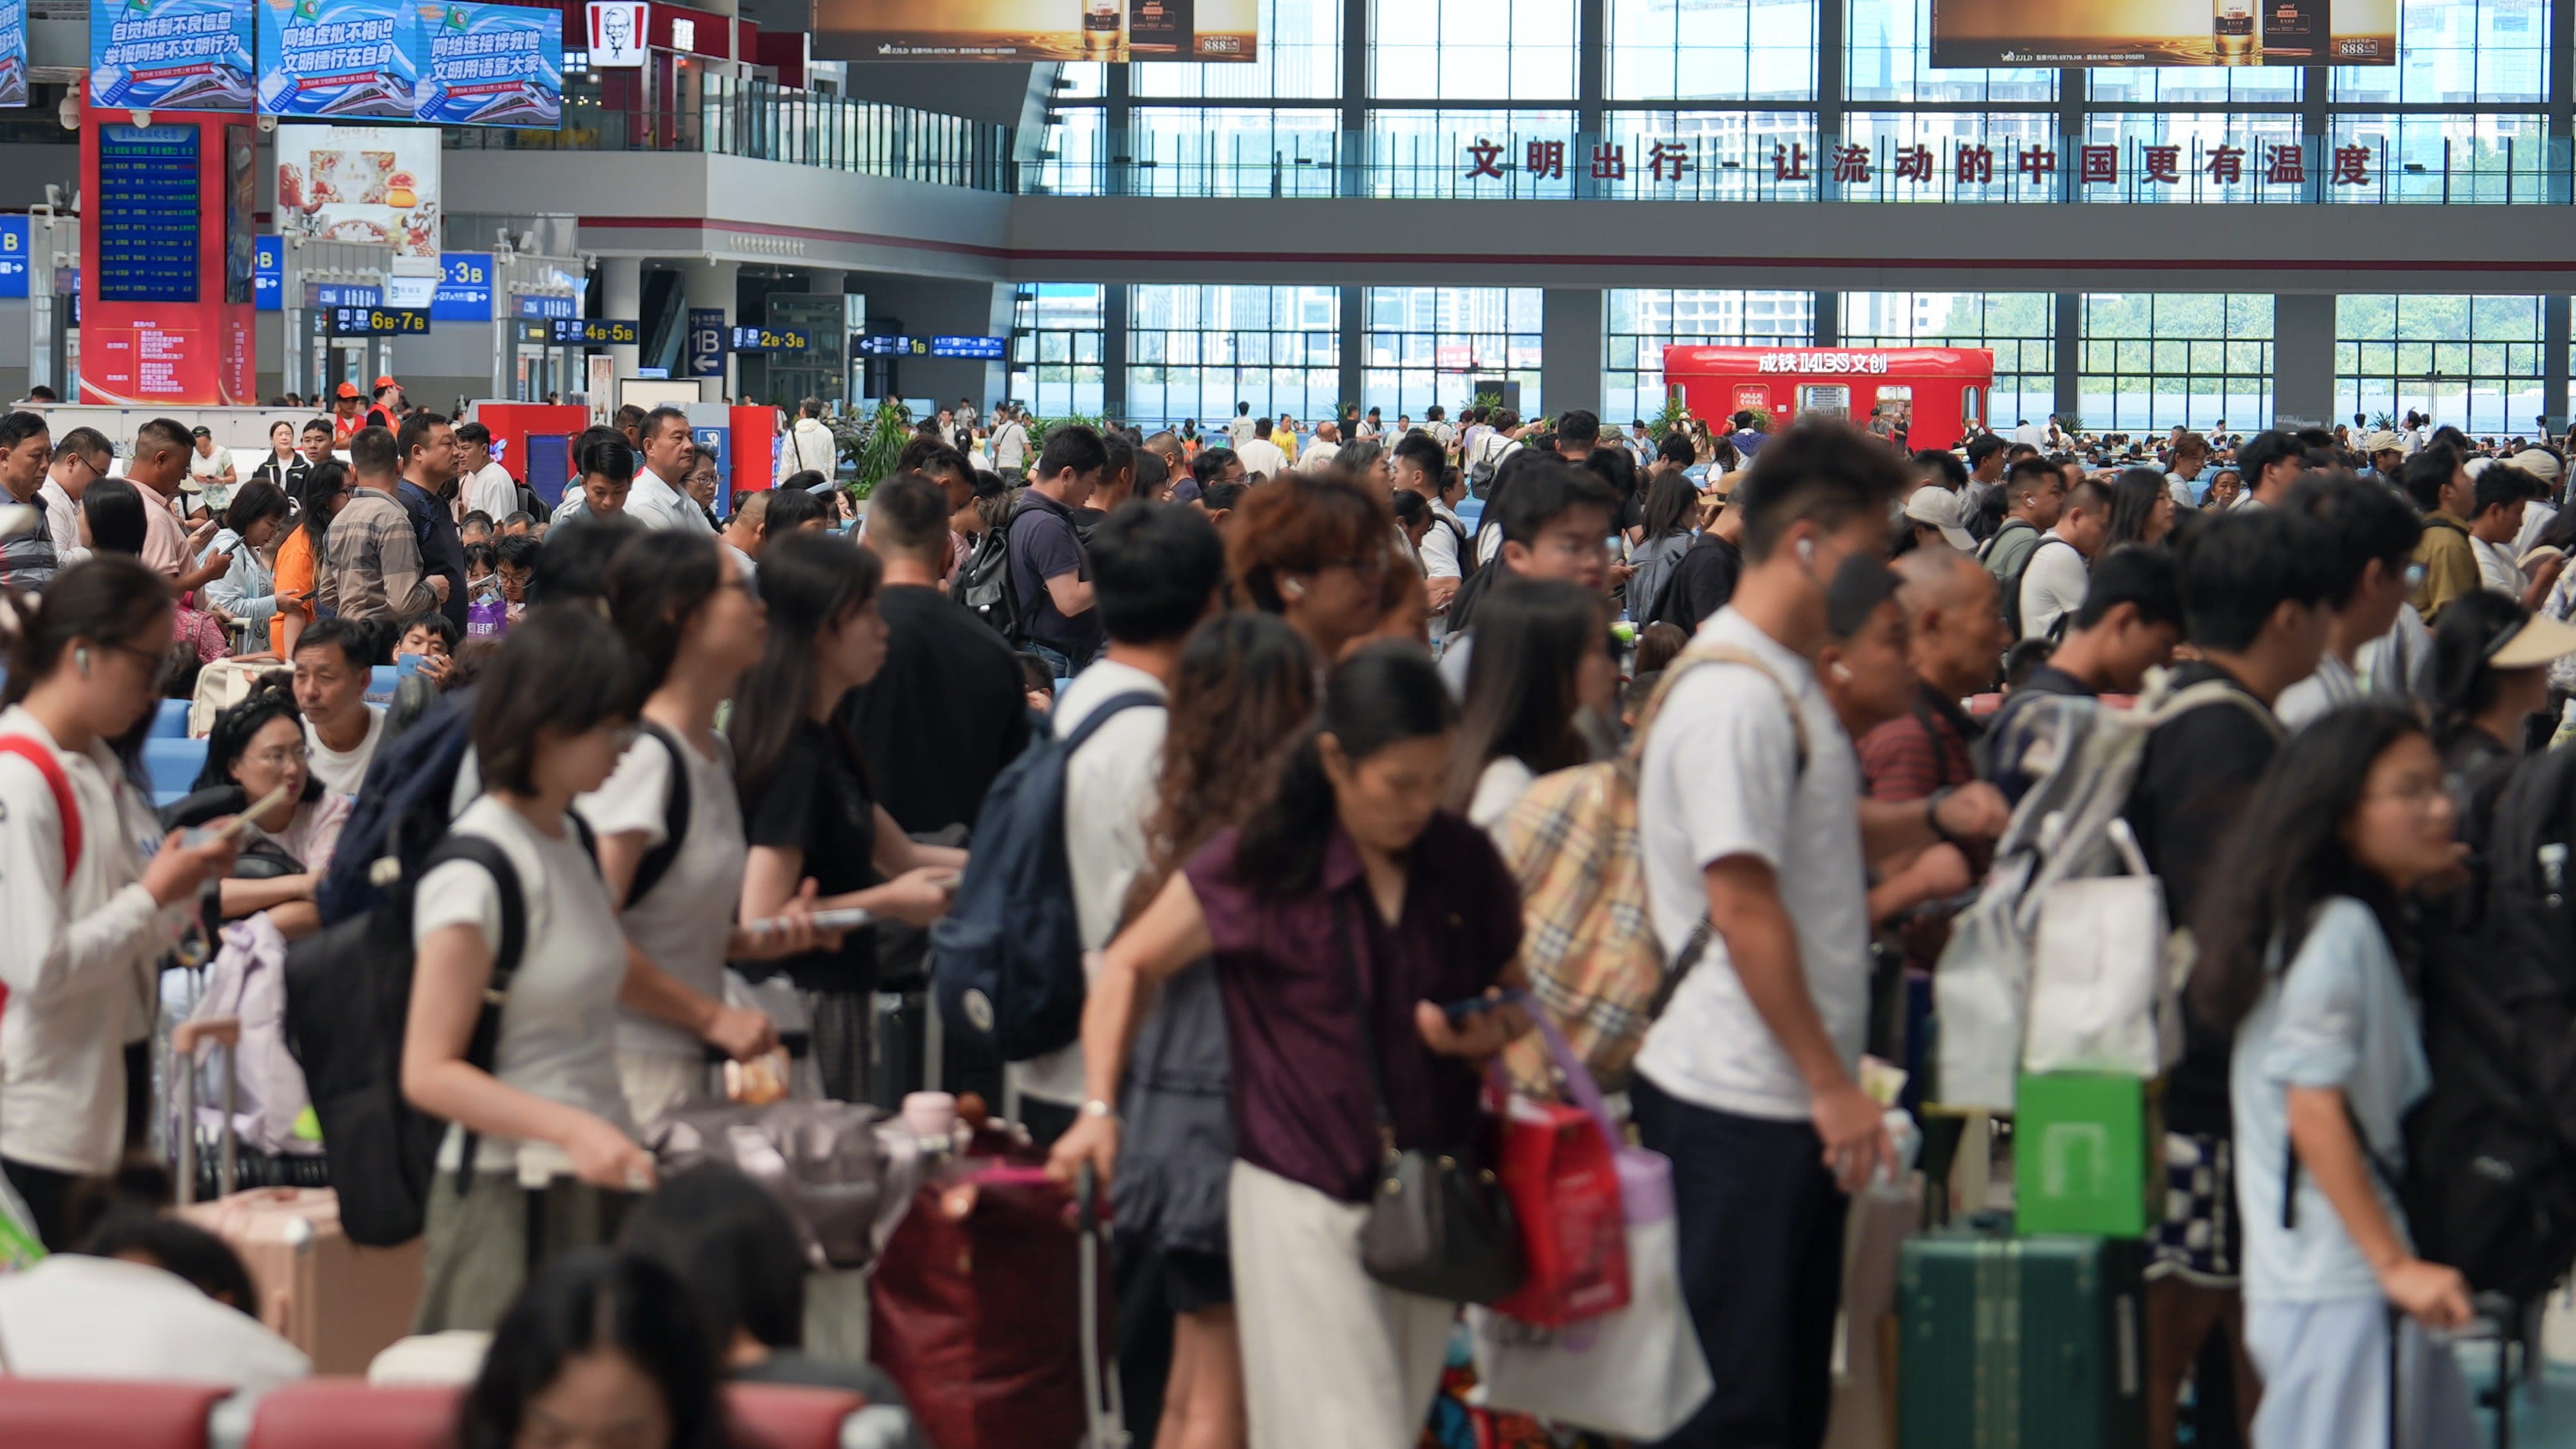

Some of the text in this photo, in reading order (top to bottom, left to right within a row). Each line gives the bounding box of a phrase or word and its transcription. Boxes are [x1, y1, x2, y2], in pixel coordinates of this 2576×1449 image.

[112, 11, 232, 41] 自觉抵制不良信息
[282, 18, 394, 49] 网络虚拟不相识
[105, 34, 239, 65] 举报网络不文明行为
[432, 30, 540, 57] 网络连接你我他
[1205, 40, 1226, 50] 888
[2342, 43, 2364, 54] 888
[282, 44, 393, 74] 文明德行在自身
[432, 54, 540, 82] 文明用语靠大家
[1466, 140, 2370, 185] 文明出行 让流动的中国更有温度
[692, 330, 719, 353] 1B
[910, 339, 926, 354] 1B
